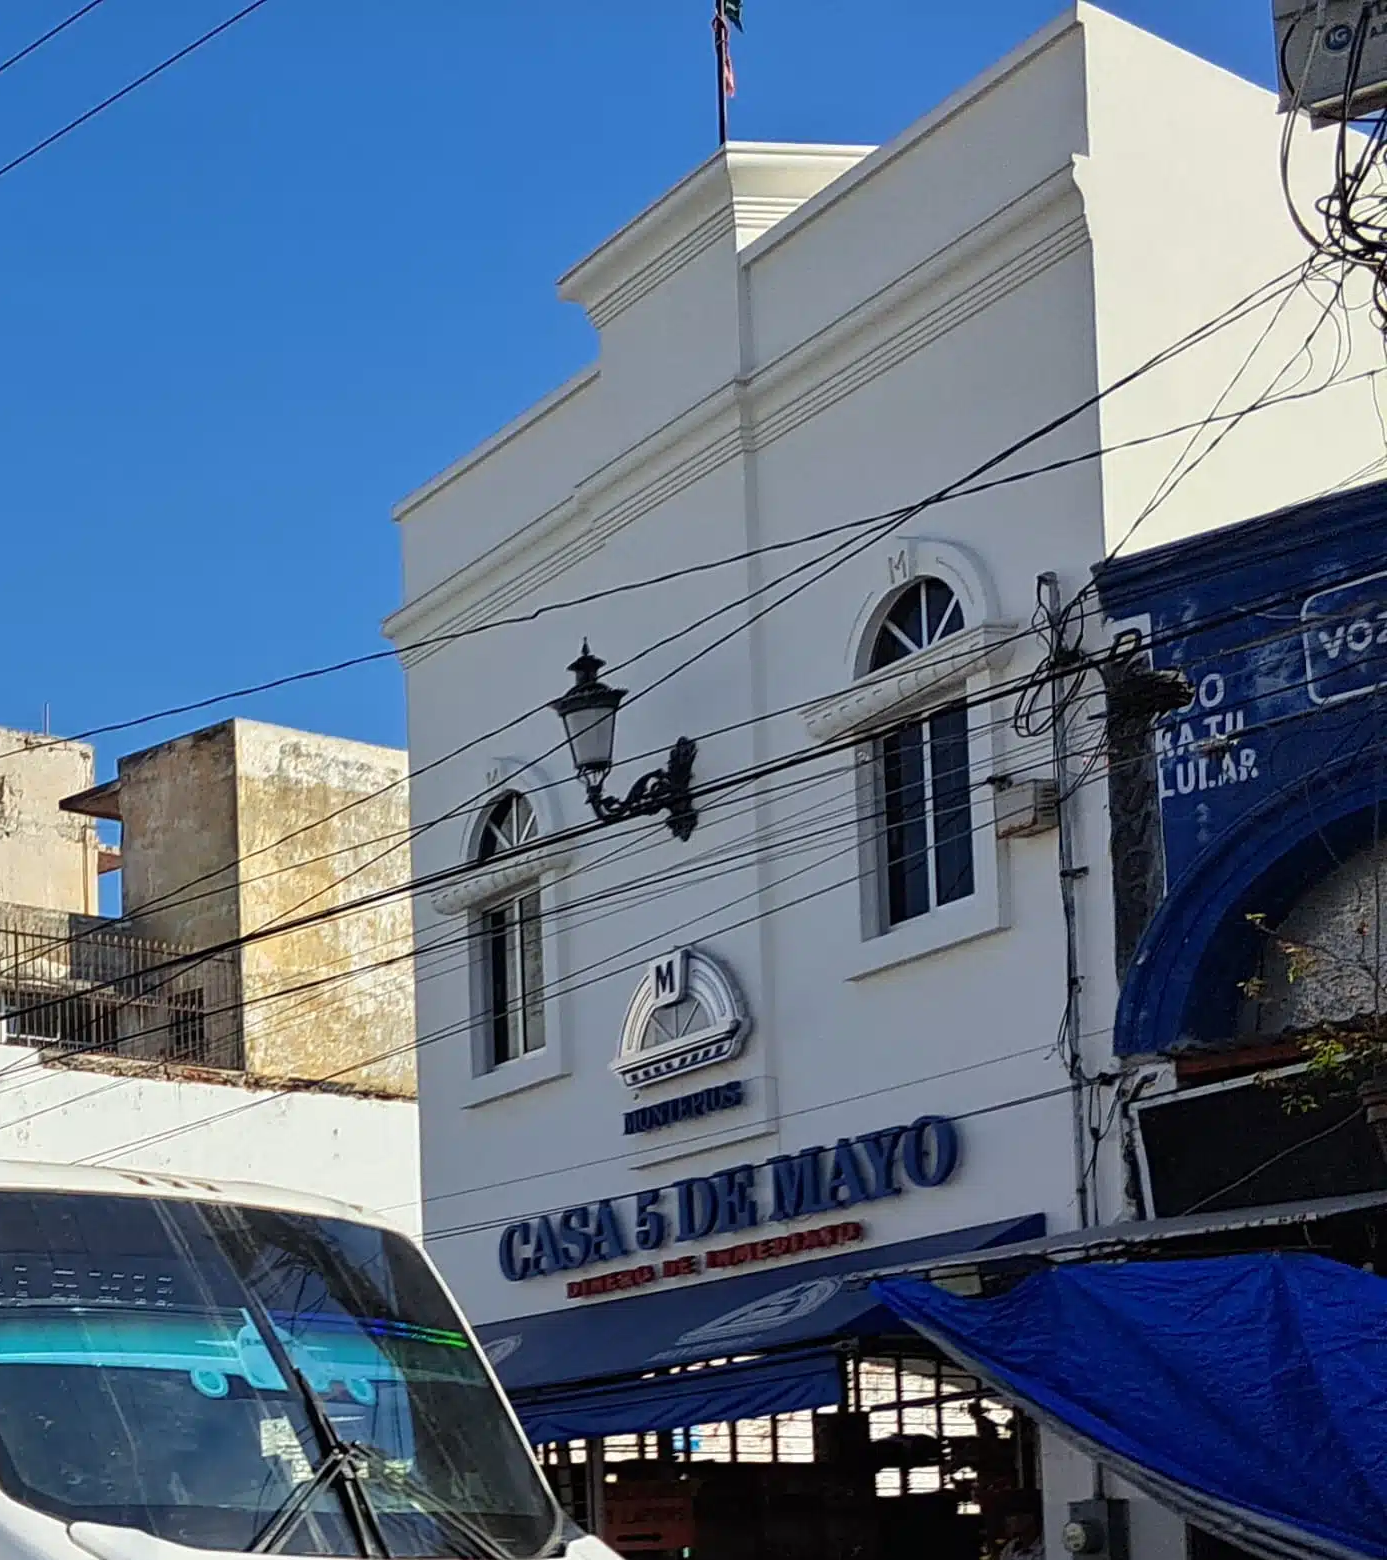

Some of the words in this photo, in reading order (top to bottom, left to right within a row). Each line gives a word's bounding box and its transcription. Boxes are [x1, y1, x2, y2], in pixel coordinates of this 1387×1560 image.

[654, 961, 675, 999] M
[499, 1199, 629, 1283] CASA
[635, 1187, 665, 1251] 5
[675, 1164, 758, 1243] DE
[767, 1114, 958, 1223] MAYO
[566, 1261, 654, 1299] DINERO
[663, 1254, 697, 1278] DE
[706, 1222, 864, 1269] INMEDIATO
